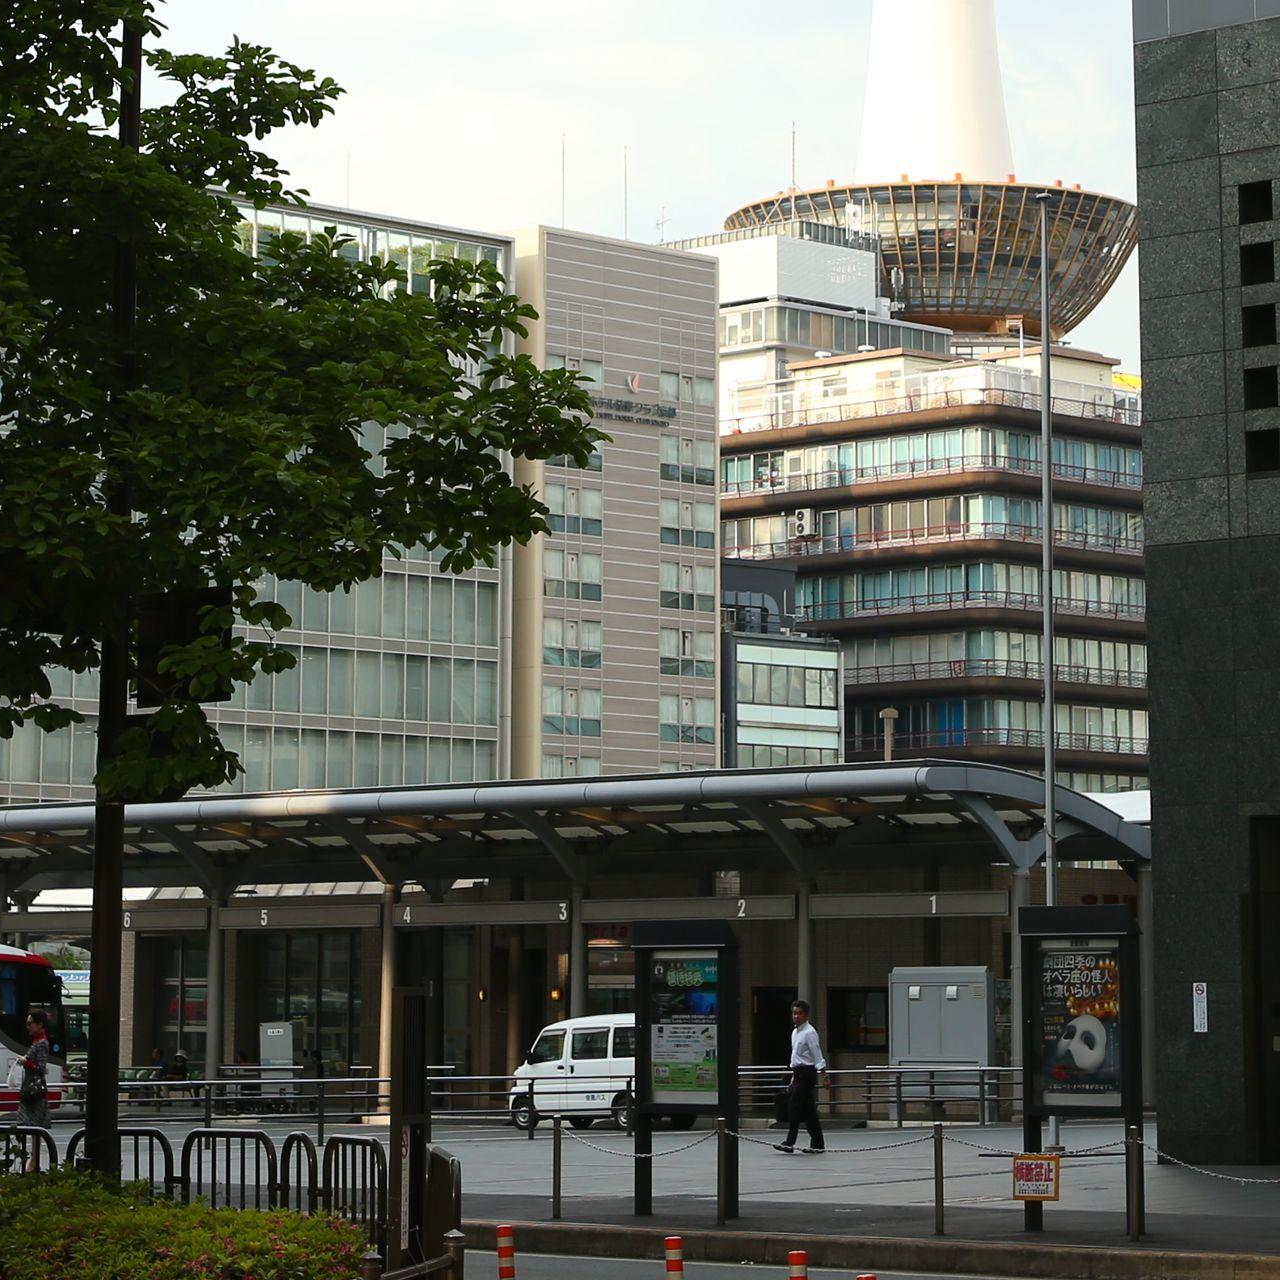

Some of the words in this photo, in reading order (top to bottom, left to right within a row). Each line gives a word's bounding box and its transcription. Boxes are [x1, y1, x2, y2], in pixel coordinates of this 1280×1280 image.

[559, 903, 567, 921] 3
[737, 899, 746, 917] 2
[929, 895, 937, 914] 1
[123, 912, 131, 928] 6
[260, 909, 268, 926] 5
[403, 906, 411, 923] 4
[57, 972, 91, 984] ybri
[1042, 969, 1113, 983] オペラ座の怪人
